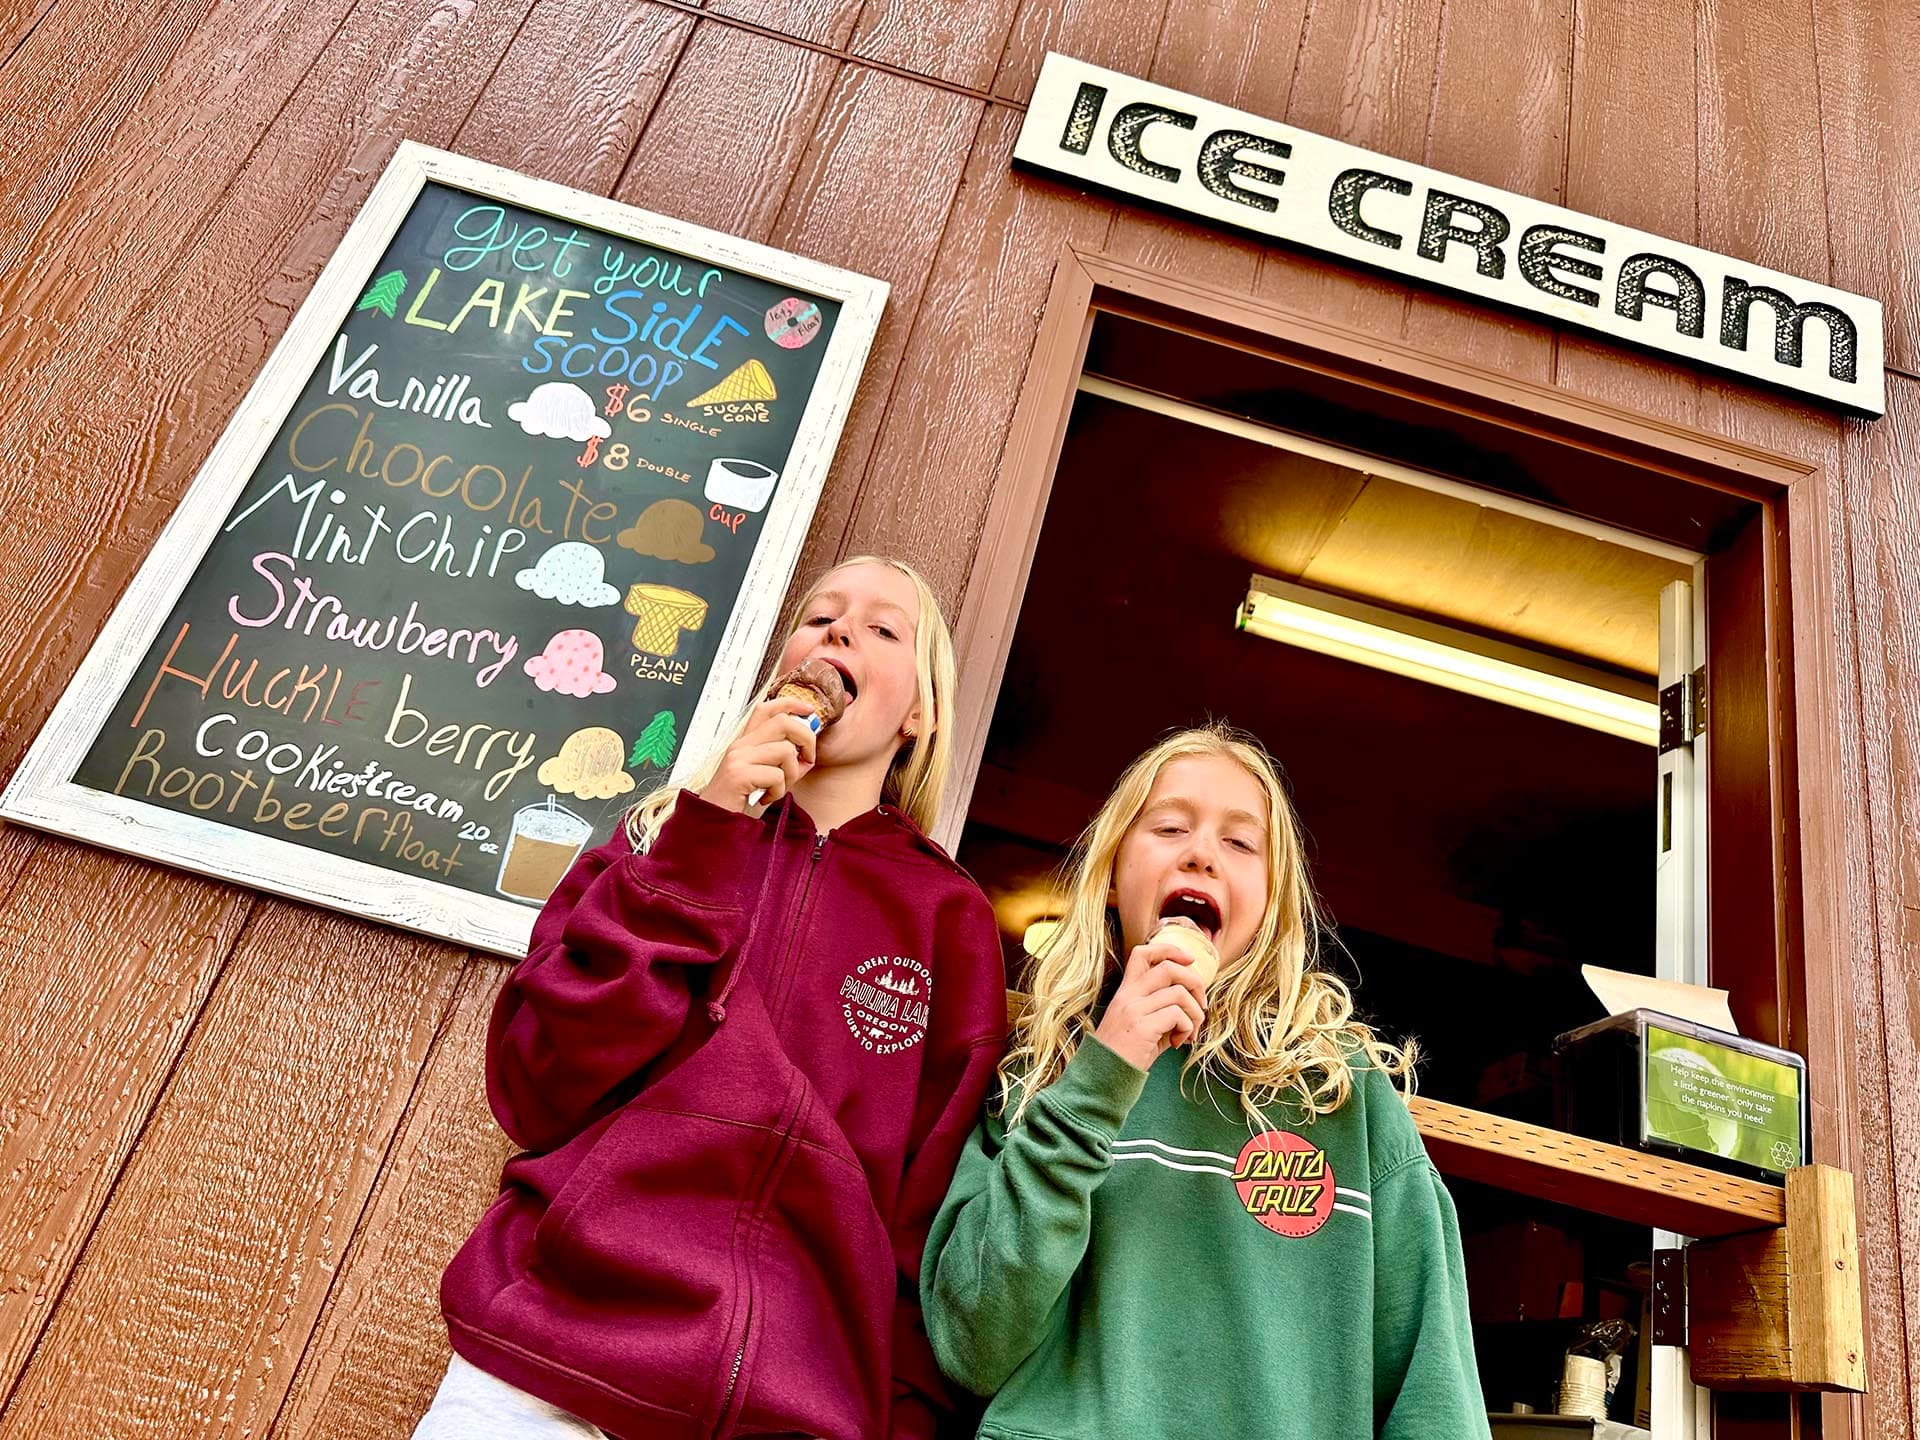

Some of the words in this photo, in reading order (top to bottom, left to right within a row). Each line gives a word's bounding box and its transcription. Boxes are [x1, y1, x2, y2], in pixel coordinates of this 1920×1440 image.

[443, 205, 590, 278] get
[594, 245, 722, 297] your
[1059, 82, 1293, 213] ICE
[1329, 168, 1858, 385] CREAM
[404, 268, 592, 338] LAKE
[327, 332, 493, 428] Vanilla
[521, 337, 686, 401] SCOOP
[605, 383, 651, 423] $6
[660, 413, 722, 437] SINGLE
[704, 402, 769, 416] SUGAR
[722, 412, 770, 423] CONE
[289, 402, 617, 544] Chocolate
[636, 457, 692, 484] DOUBLE
[225, 474, 392, 565] Mint
[228, 552, 518, 688] Strawberry
[630, 654, 690, 673] PLAIN
[635, 667, 684, 686] CONE
[384, 673, 536, 801] berry
[457, 821, 491, 841] 20
[857, 956, 888, 974] GREAT
[840, 975, 899, 1018] PAULINA
[842, 1003, 861, 1038] YOURS
[860, 1037, 873, 1051] TO
[876, 1030, 924, 1054] EXPLORE
[857, 1010, 908, 1033] OREGON
[1670, 1064, 1689, 1079] Help
[1690, 1070, 1709, 1085] keep
[1711, 1076, 1725, 1089] the
[1726, 1082, 1776, 1103] environment
[1680, 1080, 1698, 1093] little
[1699, 1087, 1730, 1102] greener
[1737, 1097, 1754, 1110] only
[1755, 1102, 1773, 1114] take
[1681, 1093, 1695, 1105] the
[1696, 1097, 1726, 1113] napkins
[1727, 1109, 1742, 1119] you
[1744, 1112, 1766, 1125] need.
[1230, 1150, 1325, 1181] SANTA
[1246, 1185, 1324, 1216] CRUZ
